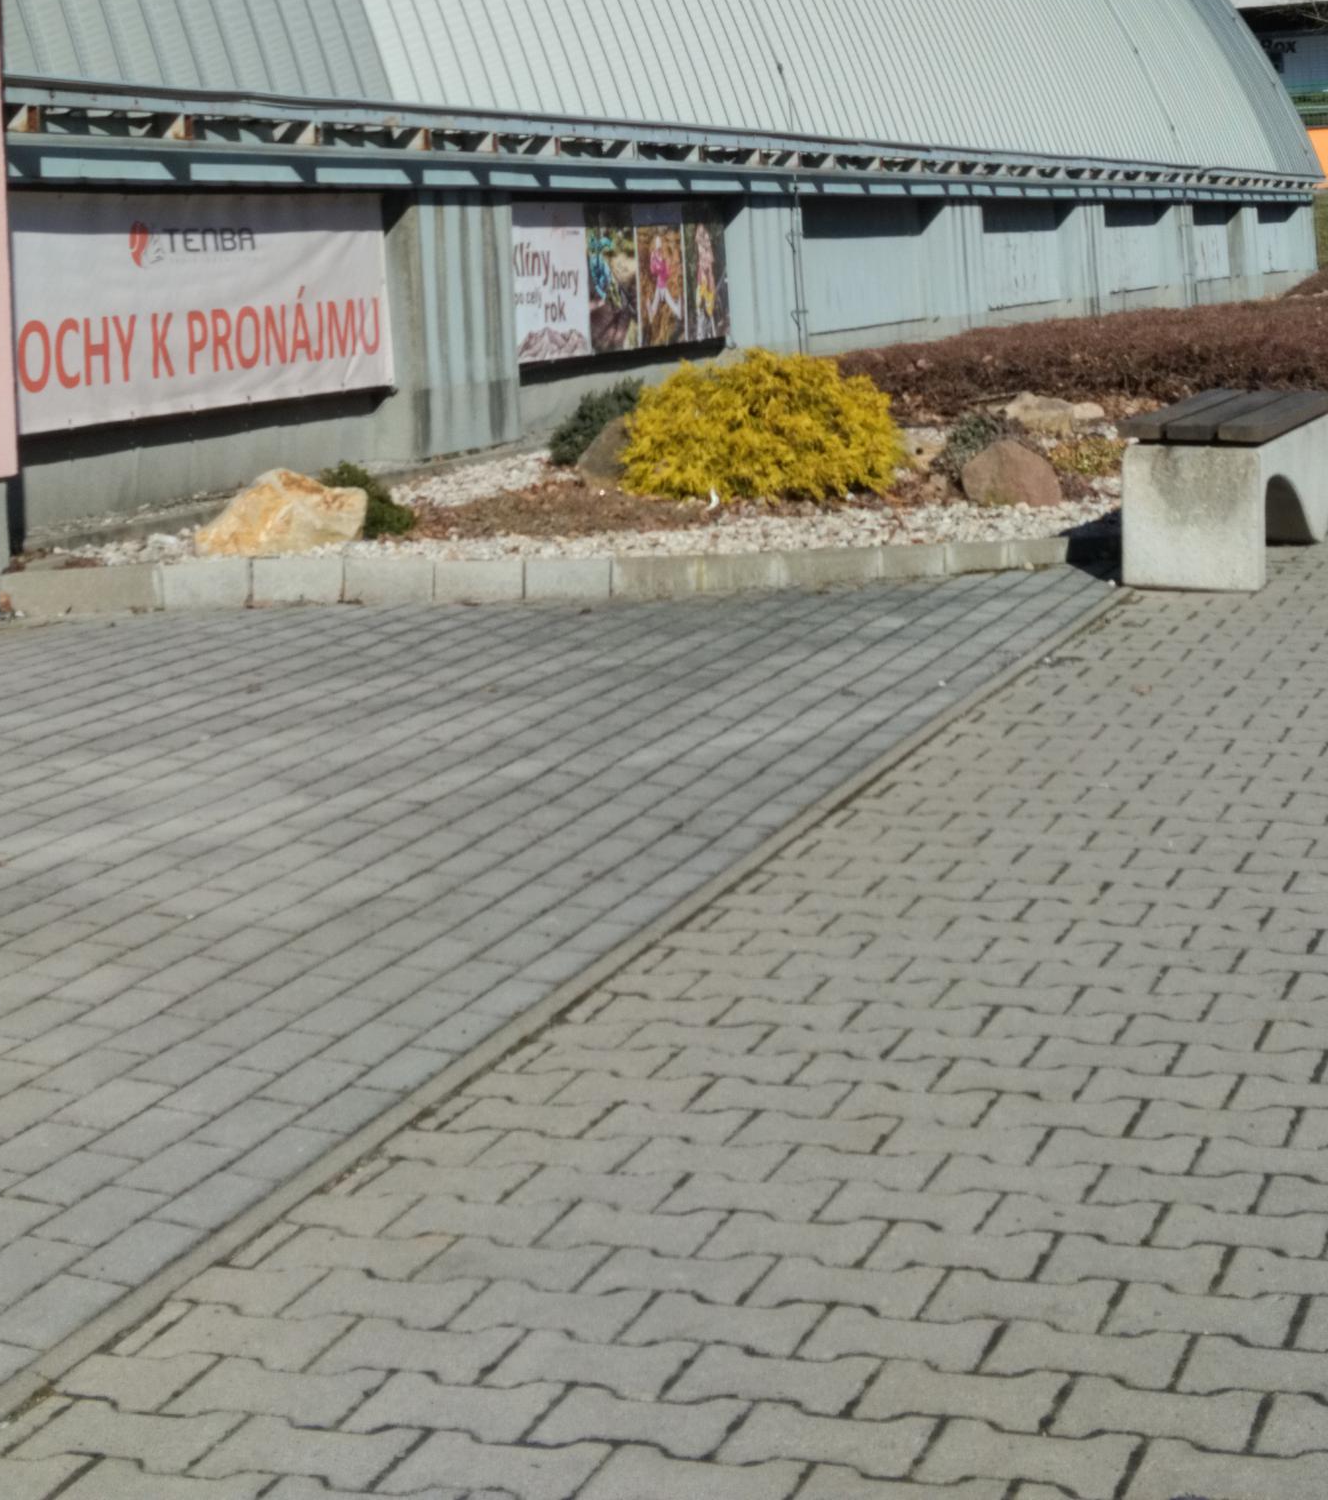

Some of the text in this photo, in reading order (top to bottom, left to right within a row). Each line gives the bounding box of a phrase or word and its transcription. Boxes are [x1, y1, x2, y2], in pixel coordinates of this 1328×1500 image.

[162, 227, 257, 253] TENBA
[552, 265, 579, 297] hory
[544, 298, 567, 324] rok
[17, 284, 382, 393] OCHY K PRONÁJMU
